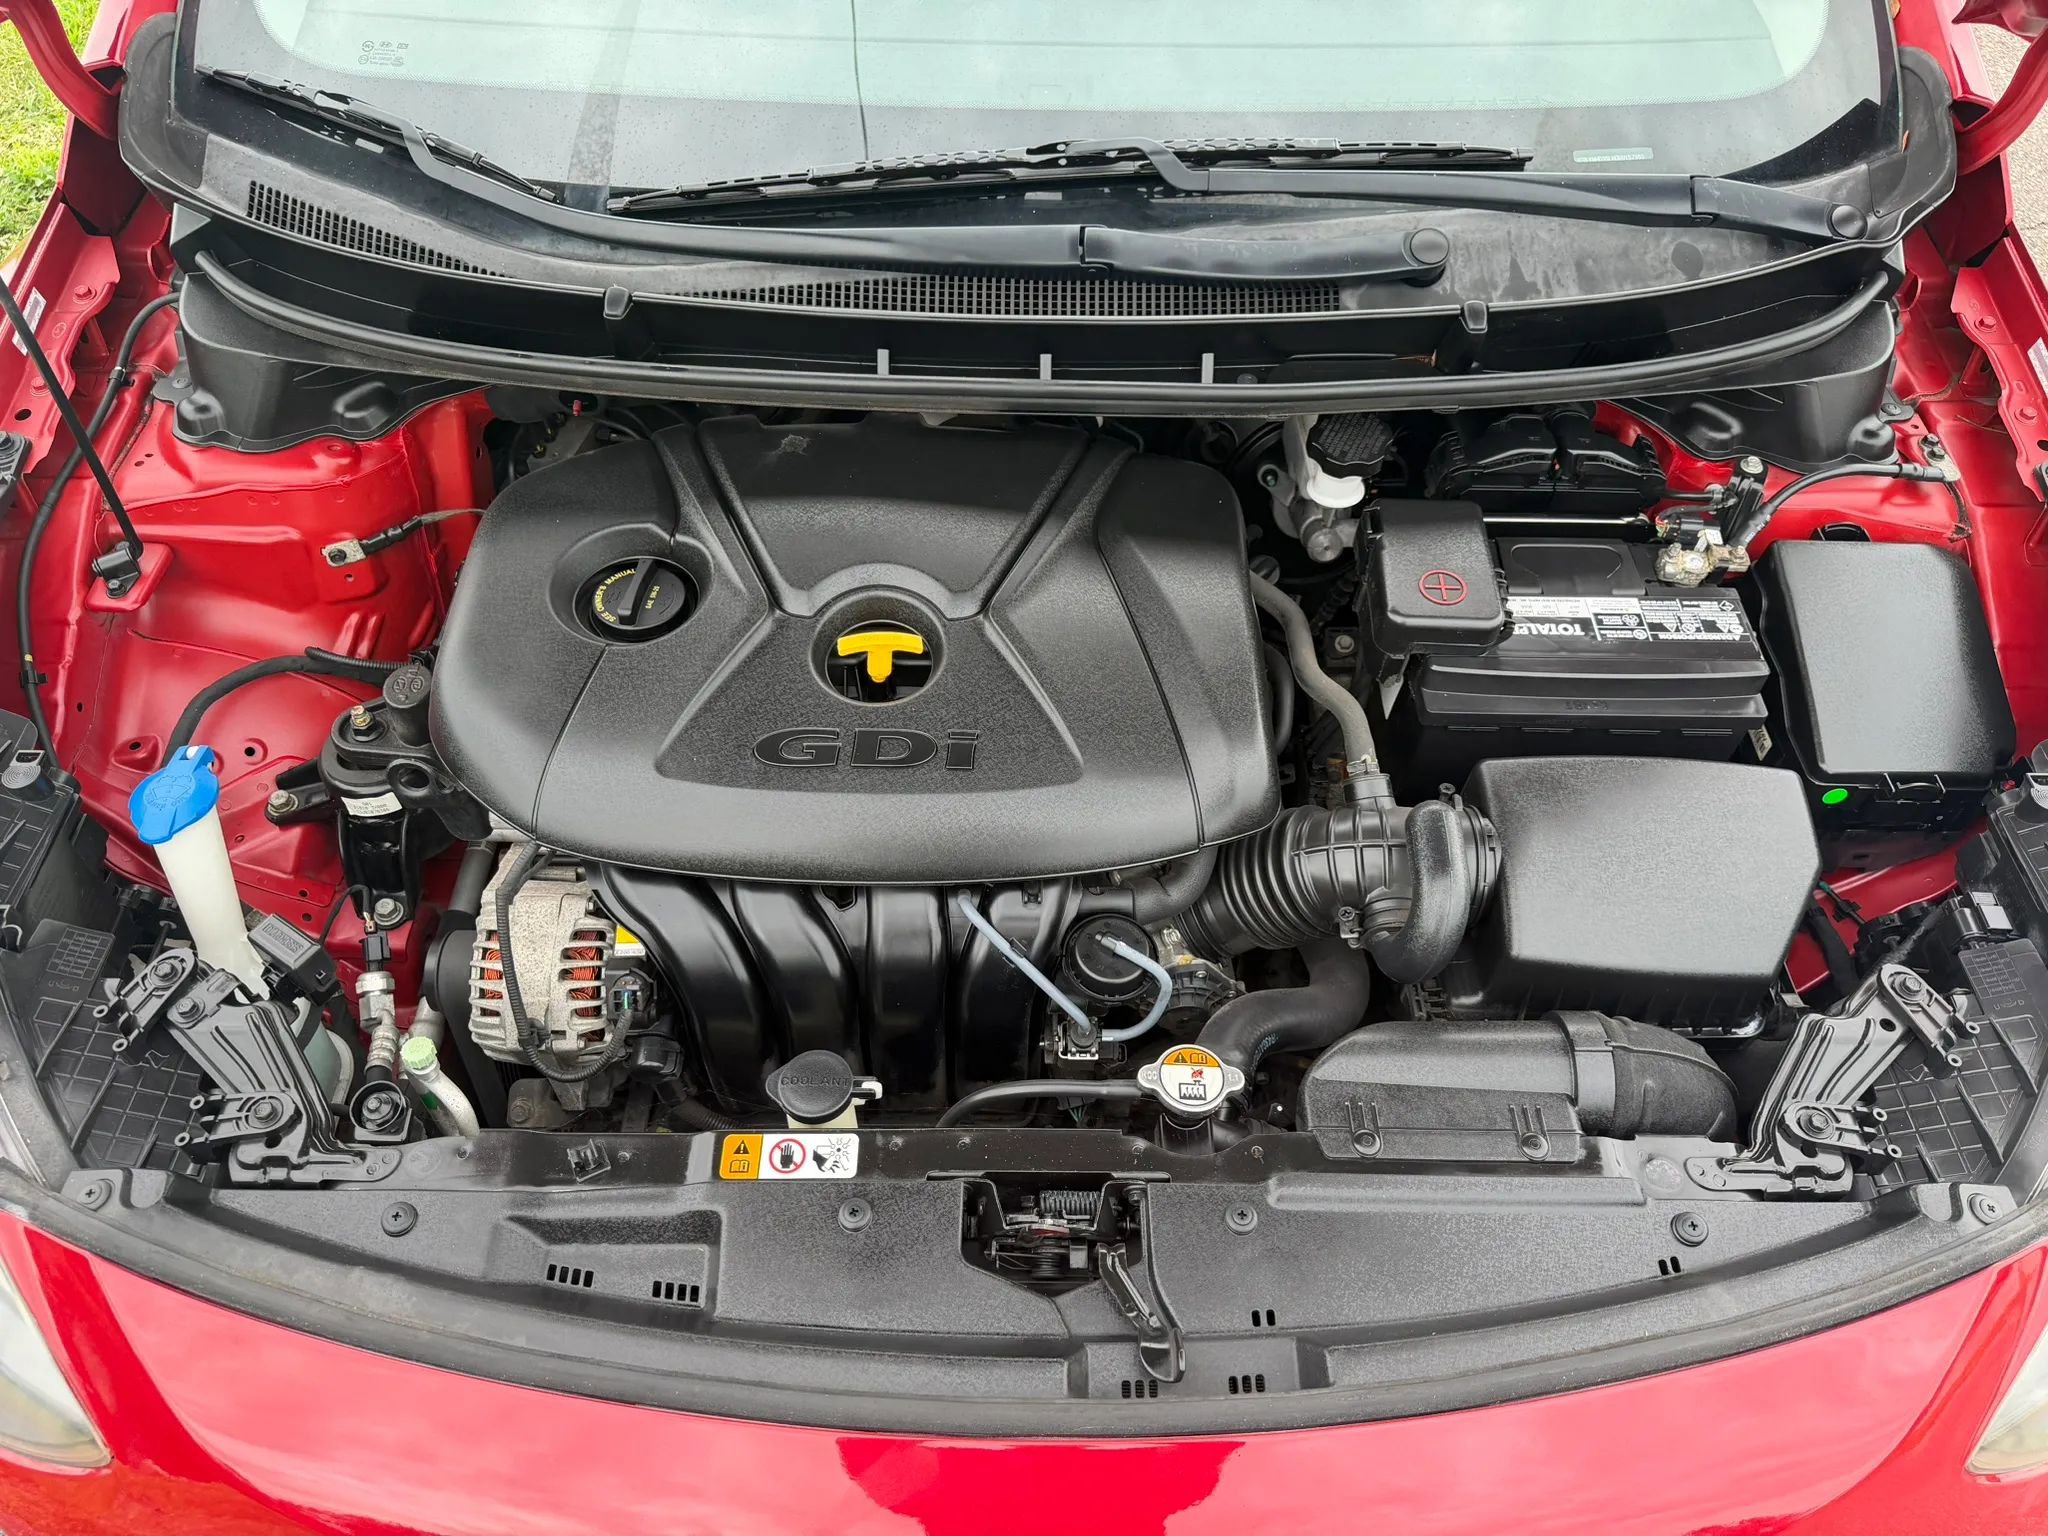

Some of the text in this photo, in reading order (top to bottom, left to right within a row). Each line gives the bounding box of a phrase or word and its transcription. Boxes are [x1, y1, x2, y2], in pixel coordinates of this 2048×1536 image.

[604, 568, 636, 584] MANUAL
[752, 726, 980, 770] GDi
[780, 1075, 851, 1089] COOLANT
